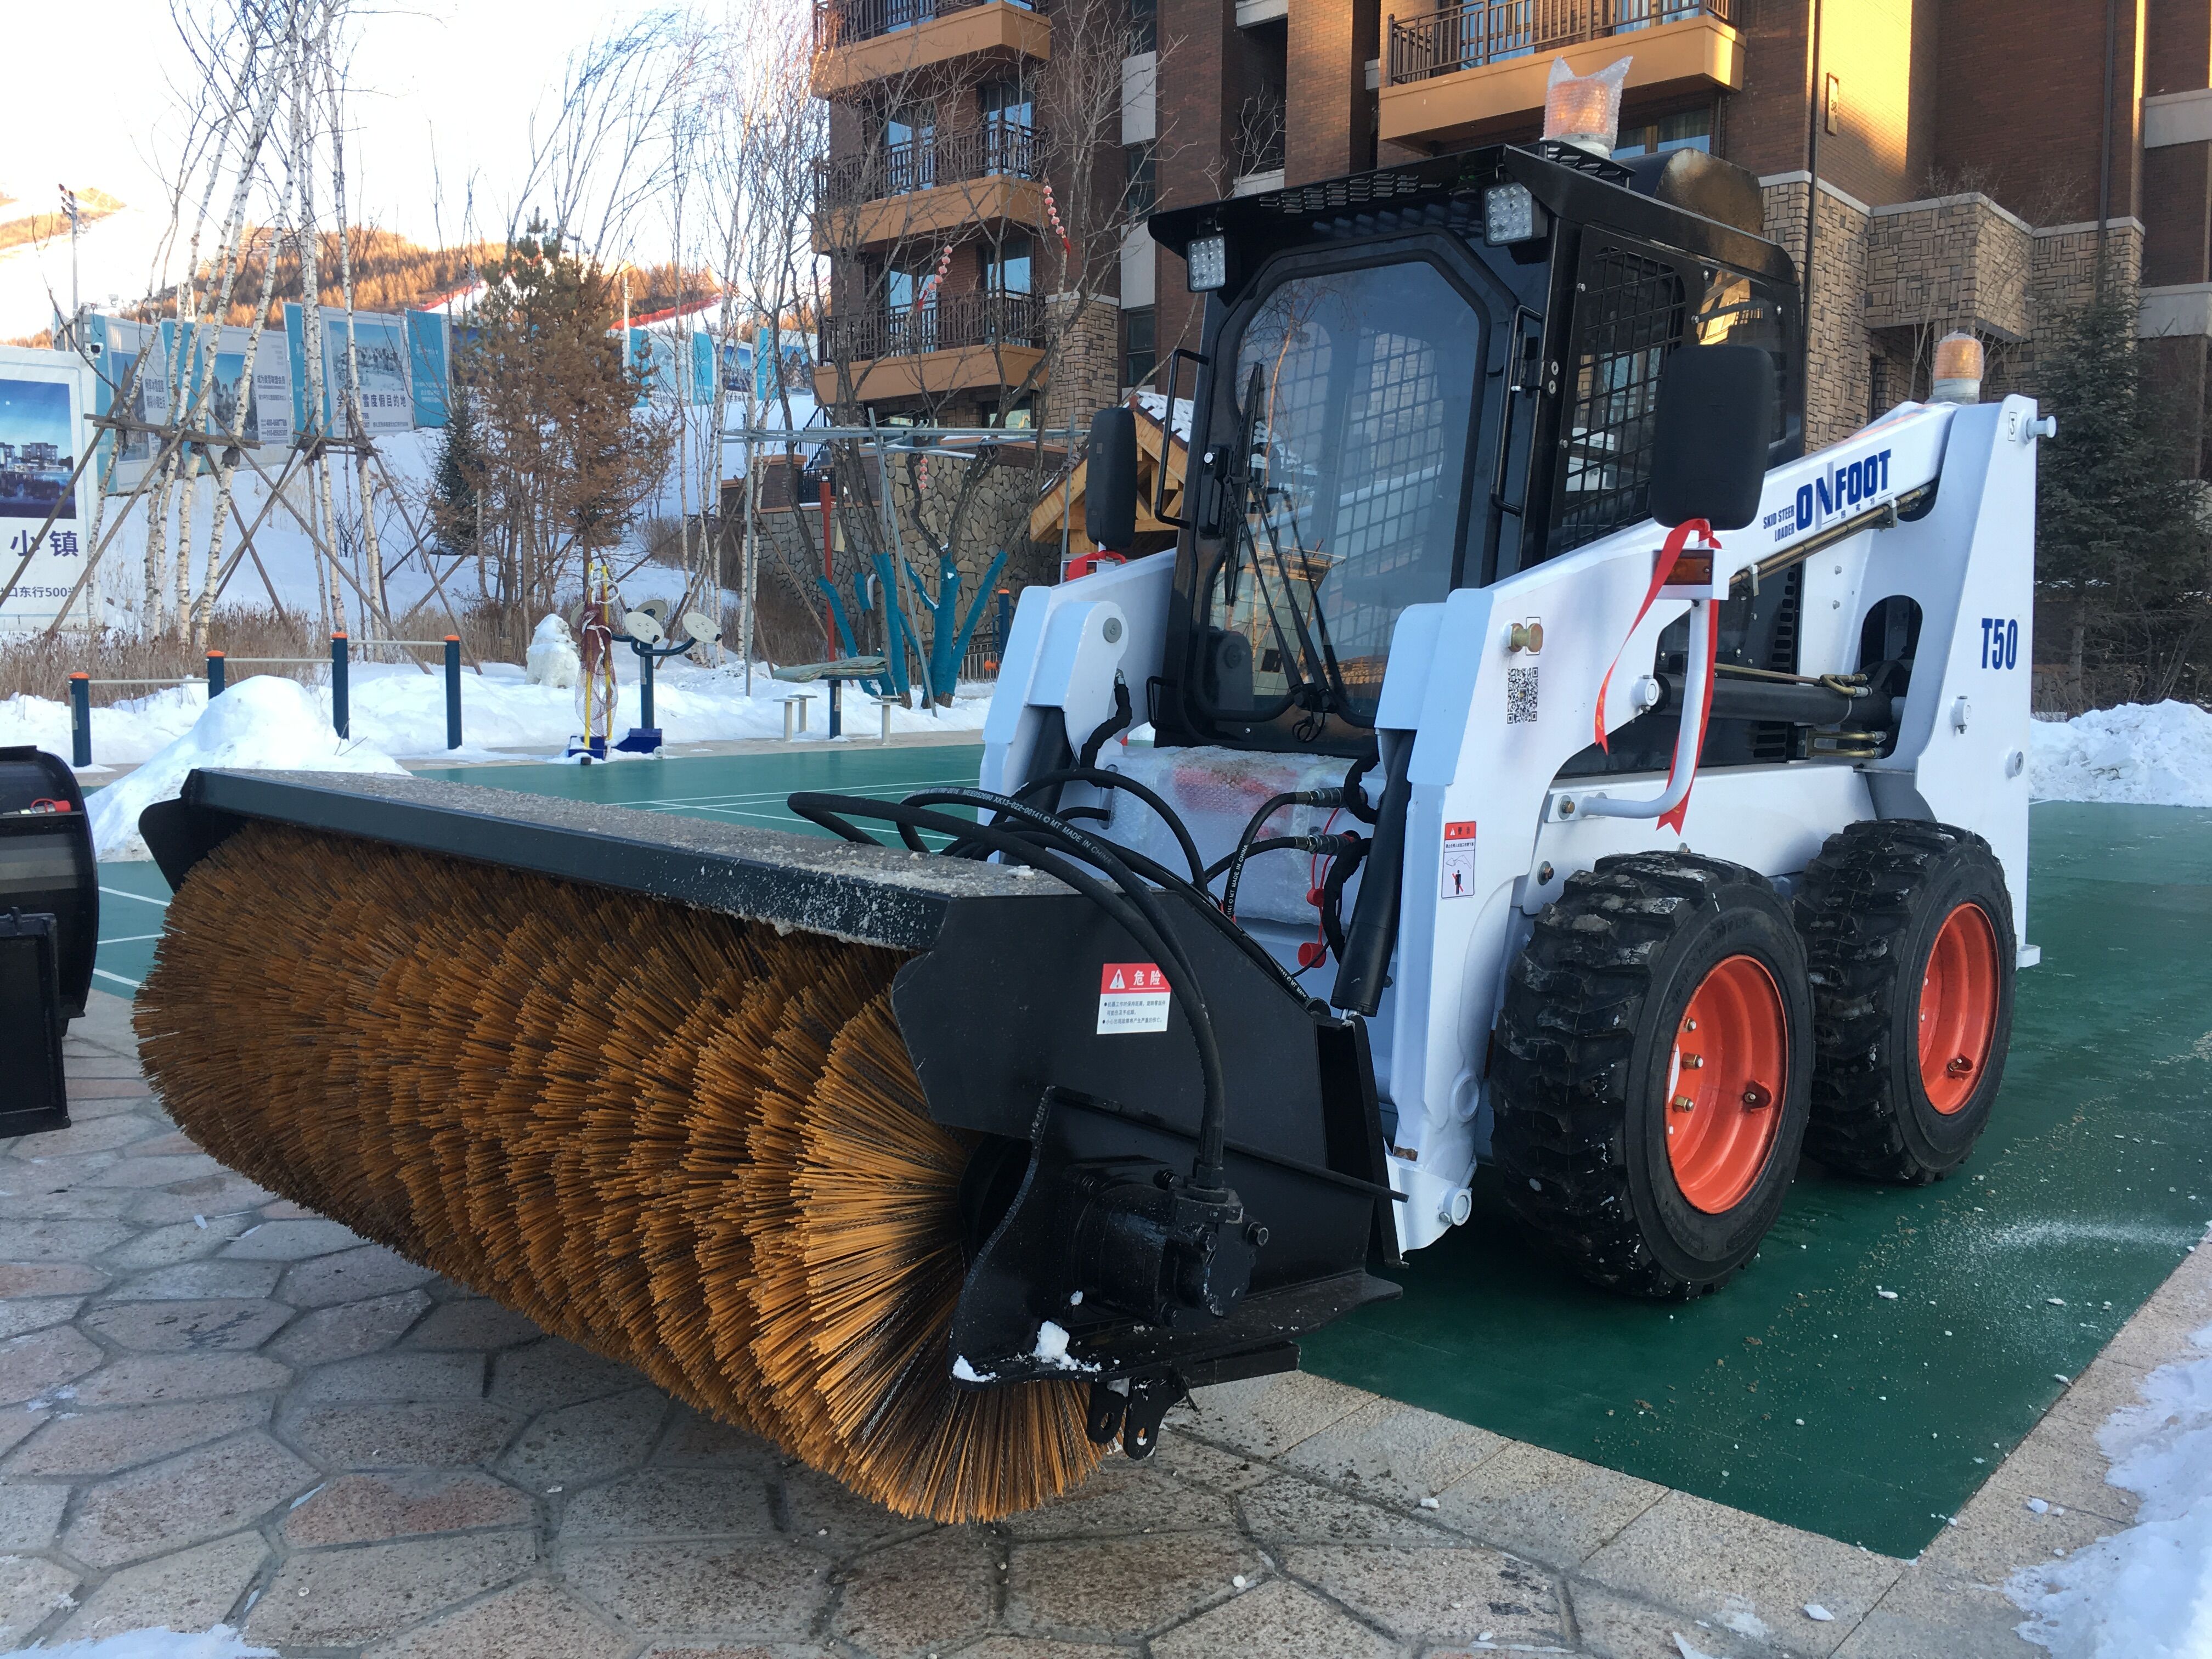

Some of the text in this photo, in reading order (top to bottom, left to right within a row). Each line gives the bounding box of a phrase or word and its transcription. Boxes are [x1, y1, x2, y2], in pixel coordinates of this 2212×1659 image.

[1796, 448, 1891, 531] ONFOOT
[1763, 505, 1795, 529] SKID STEER
[10, 529, 78, 557] 小镇
[1775, 522, 1795, 542] LOADER
[1982, 618, 2018, 670] T50
[1062, 826, 1082, 843] MADE
[1082, 839, 1092, 849] IN
[1091, 846, 1114, 866] CHINA
[1238, 844, 1248, 862] CHINA
[1133, 970, 1161, 986] 危险
